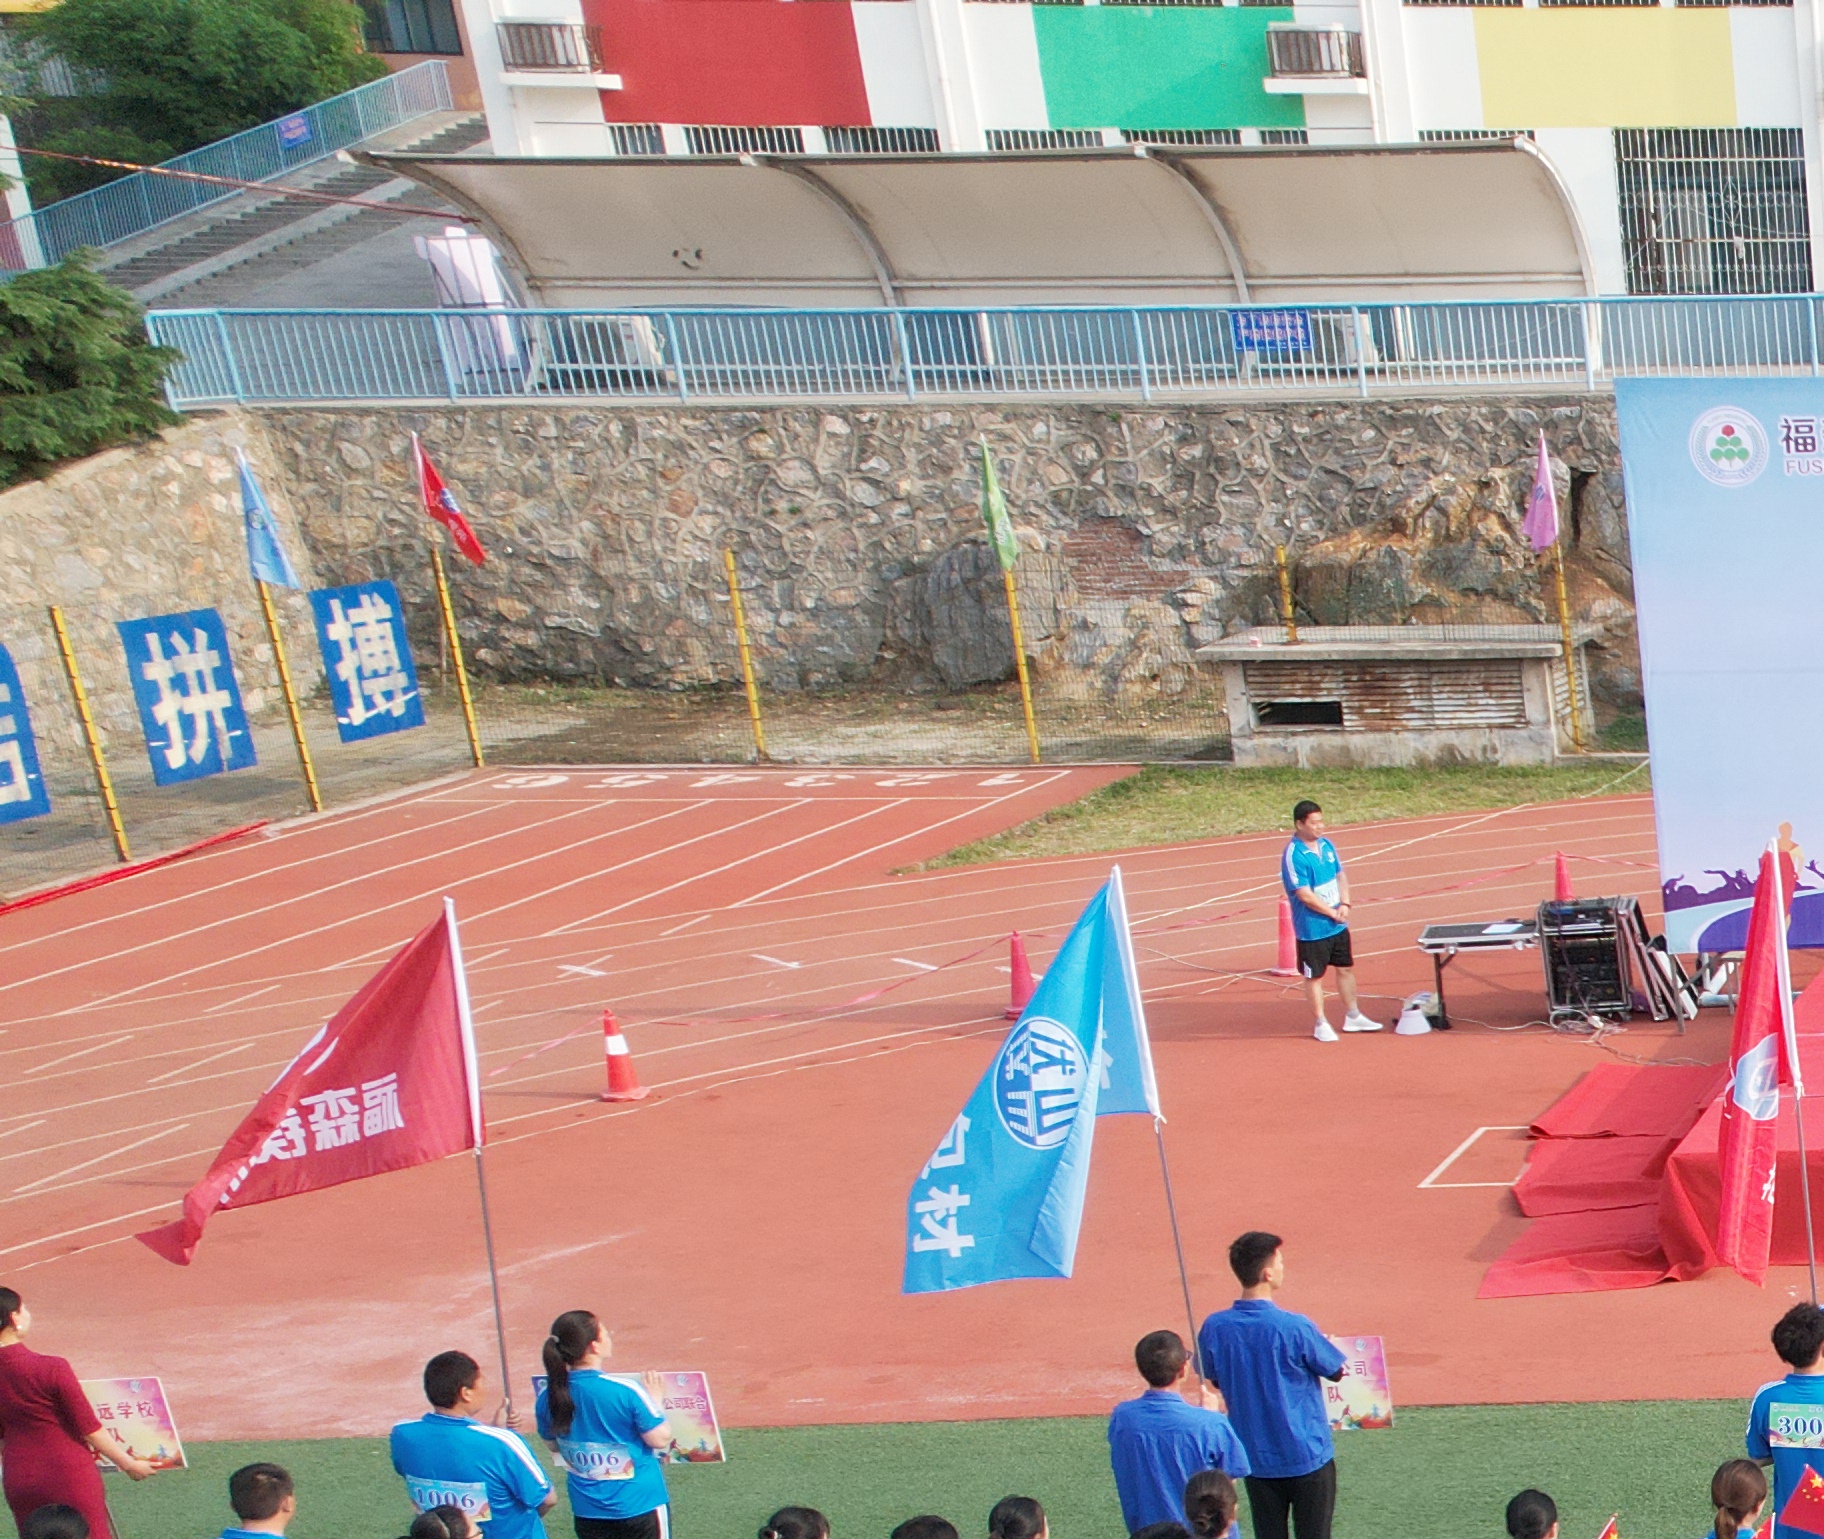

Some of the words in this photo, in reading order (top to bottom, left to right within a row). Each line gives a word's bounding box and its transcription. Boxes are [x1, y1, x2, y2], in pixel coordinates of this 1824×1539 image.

[326, 592, 411, 727] 搏
[140, 626, 235, 772] 拼
[97, 1401, 155, 1420] 远学校
[1327, 1386, 1344, 1403] 队
